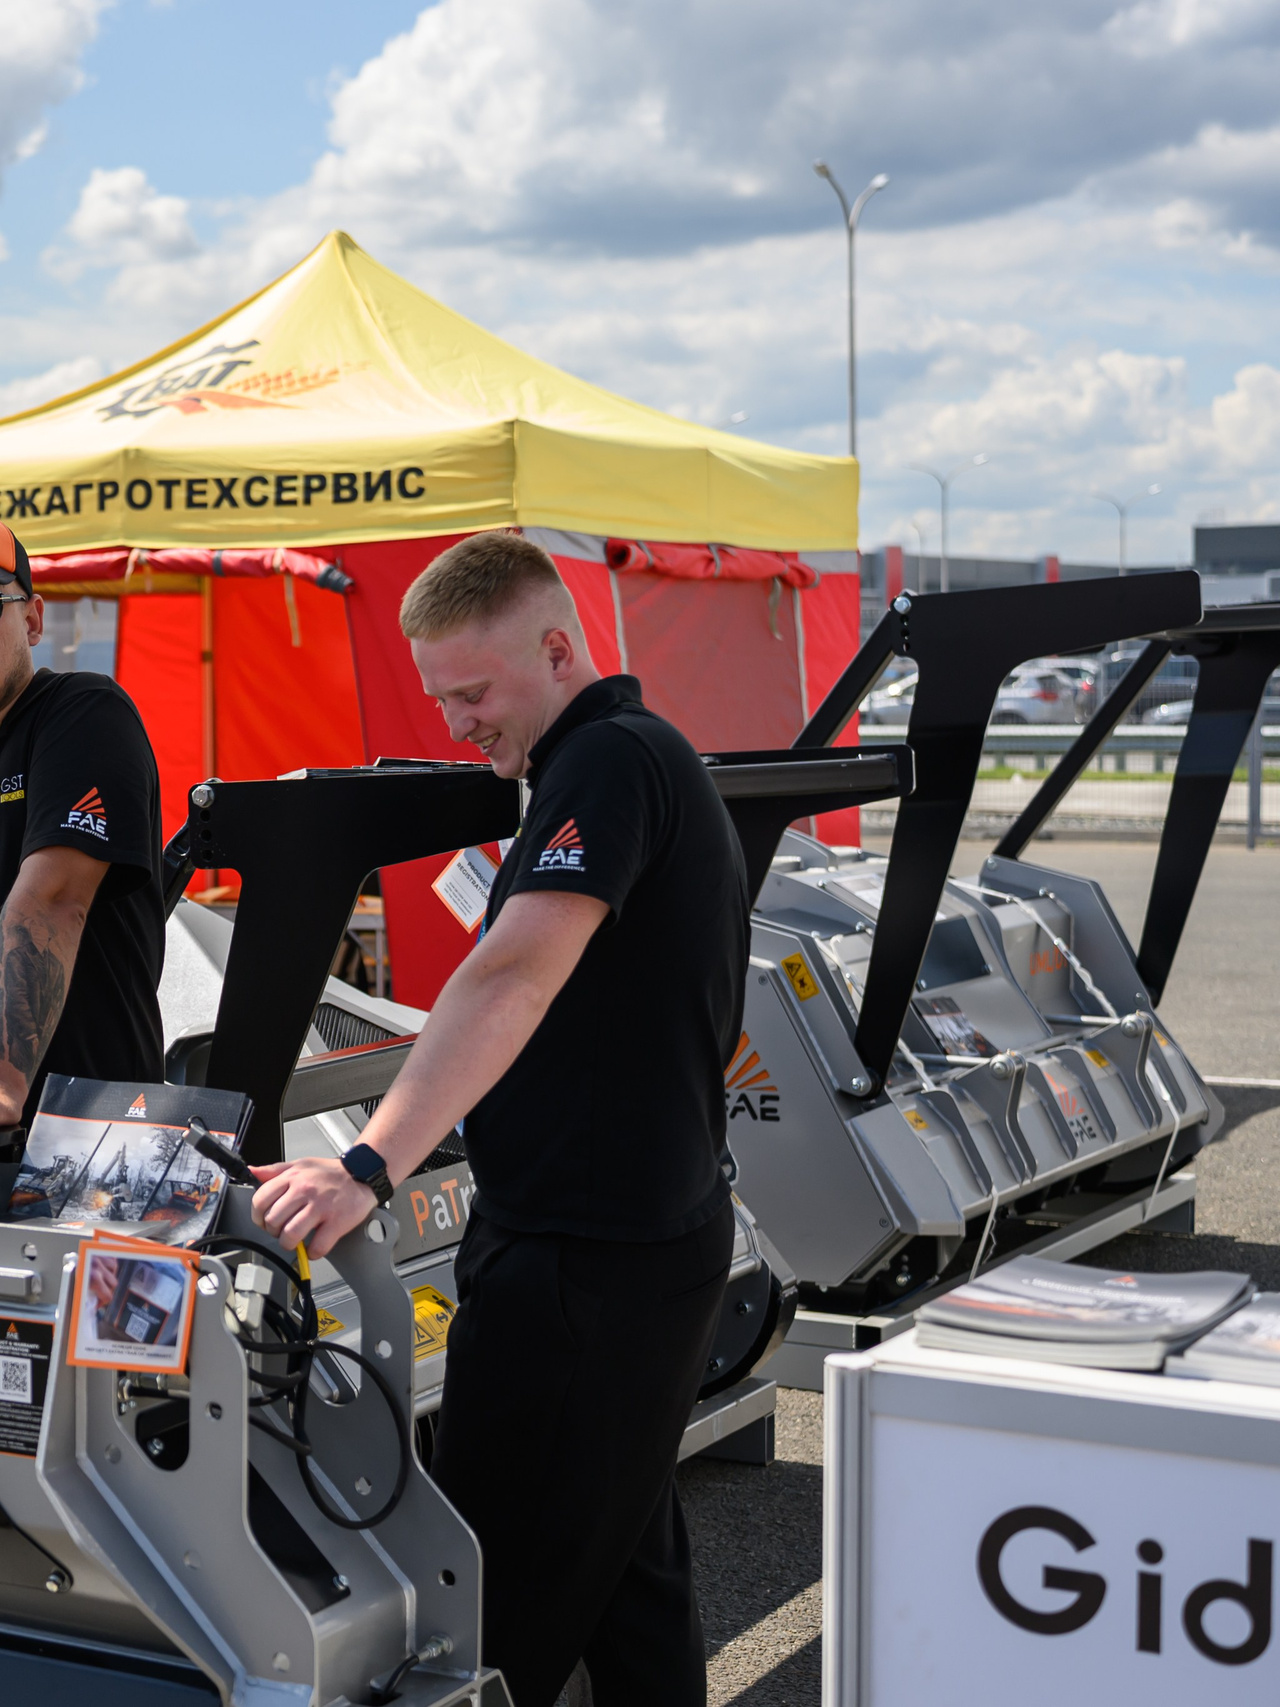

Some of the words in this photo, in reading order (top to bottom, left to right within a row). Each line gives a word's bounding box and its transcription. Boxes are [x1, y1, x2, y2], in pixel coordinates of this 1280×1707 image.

[1, 774, 23, 793] GST
[68, 811, 107, 834] FAE
[539, 848, 584, 866] FAE
[456, 862, 490, 902] REGISTRATION
[467, 861, 491, 889] PRODUCT
[977, 1505, 1273, 1665] Gid
